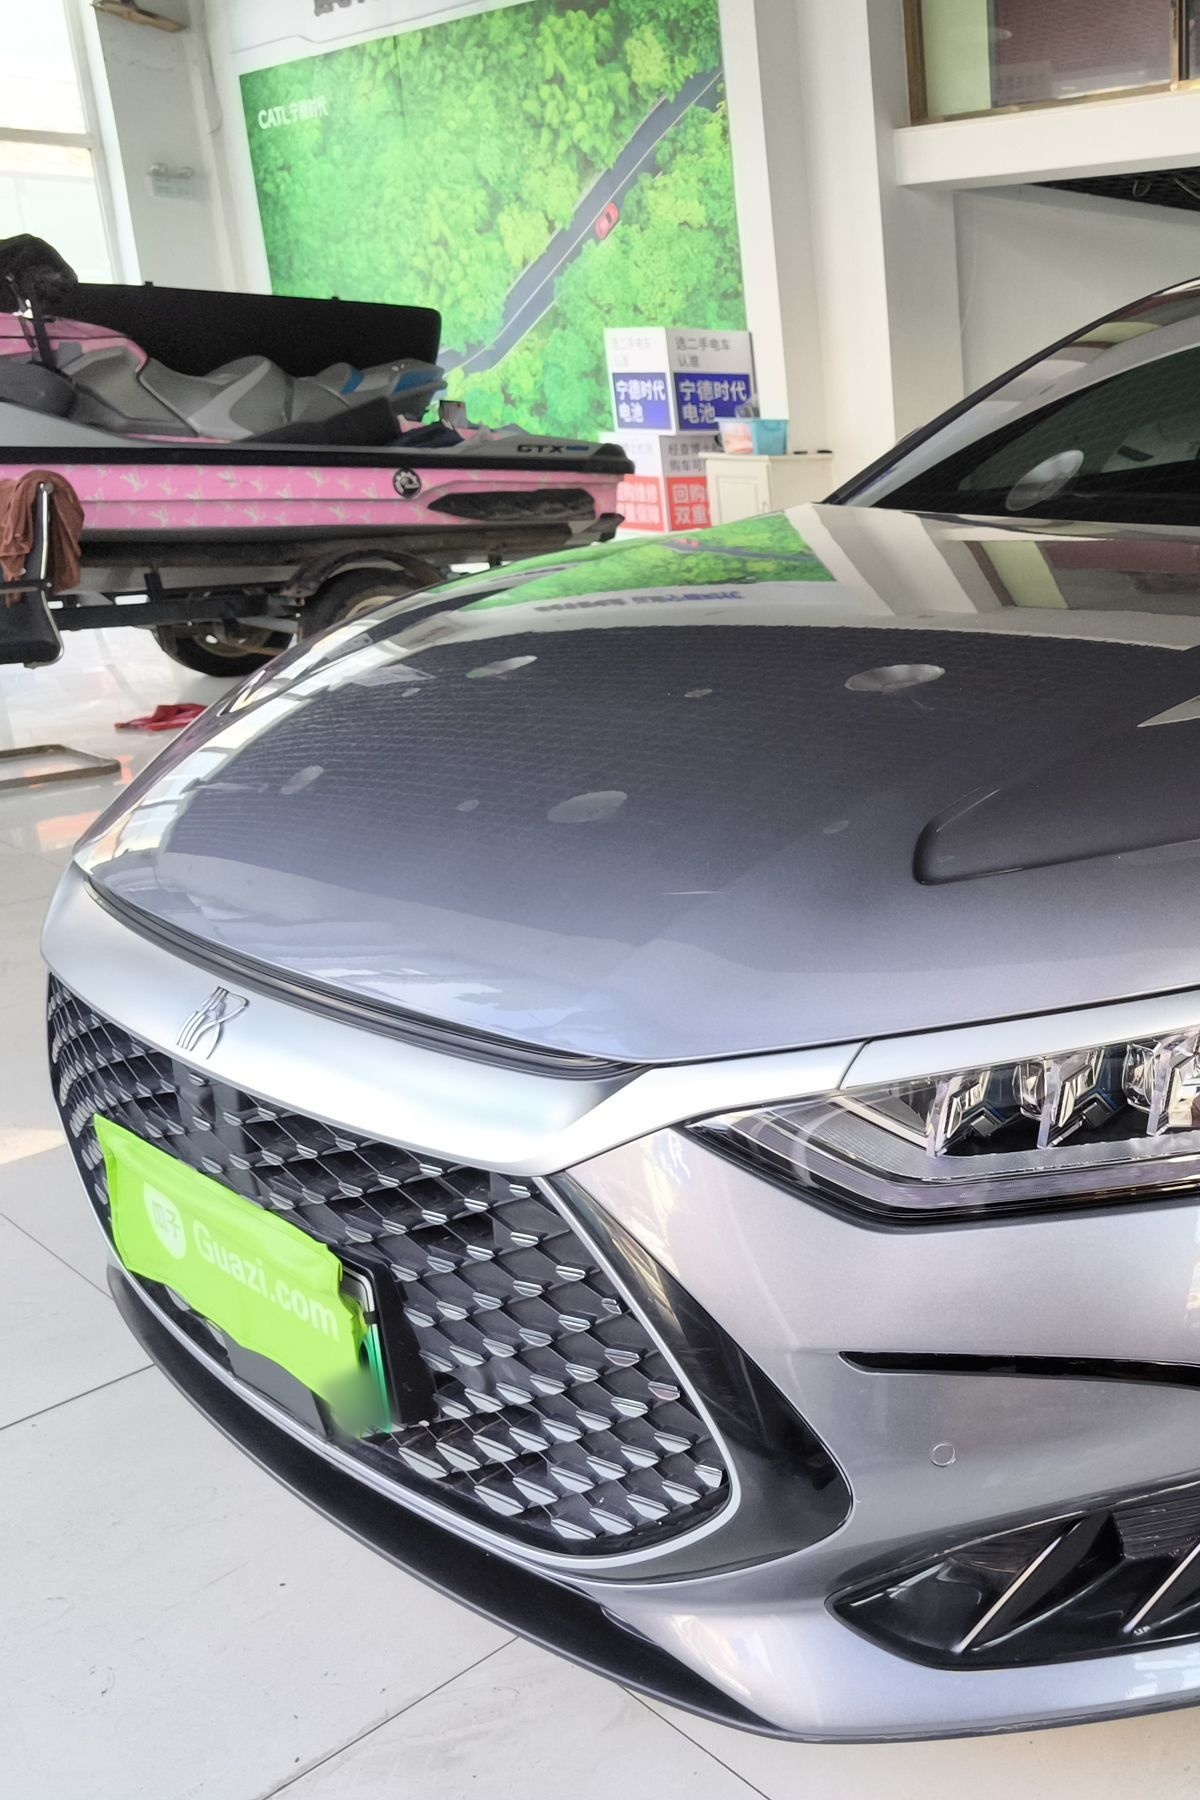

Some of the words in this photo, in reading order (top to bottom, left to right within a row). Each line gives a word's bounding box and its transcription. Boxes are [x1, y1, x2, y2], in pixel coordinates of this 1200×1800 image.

[257, 106, 290, 129] CATL
[675, 336, 731, 351] 选二手电车
[678, 354, 699, 367] 认准
[615, 378, 666, 402] 宁德时代
[678, 379, 748, 402] 宁德时代
[618, 401, 644, 423] 电池
[681, 402, 715, 424] 电池
[517, 444, 564, 454] GTX
[150, 1199, 182, 1241] 瓜子
[192, 1220, 340, 1343] Guazi.com
